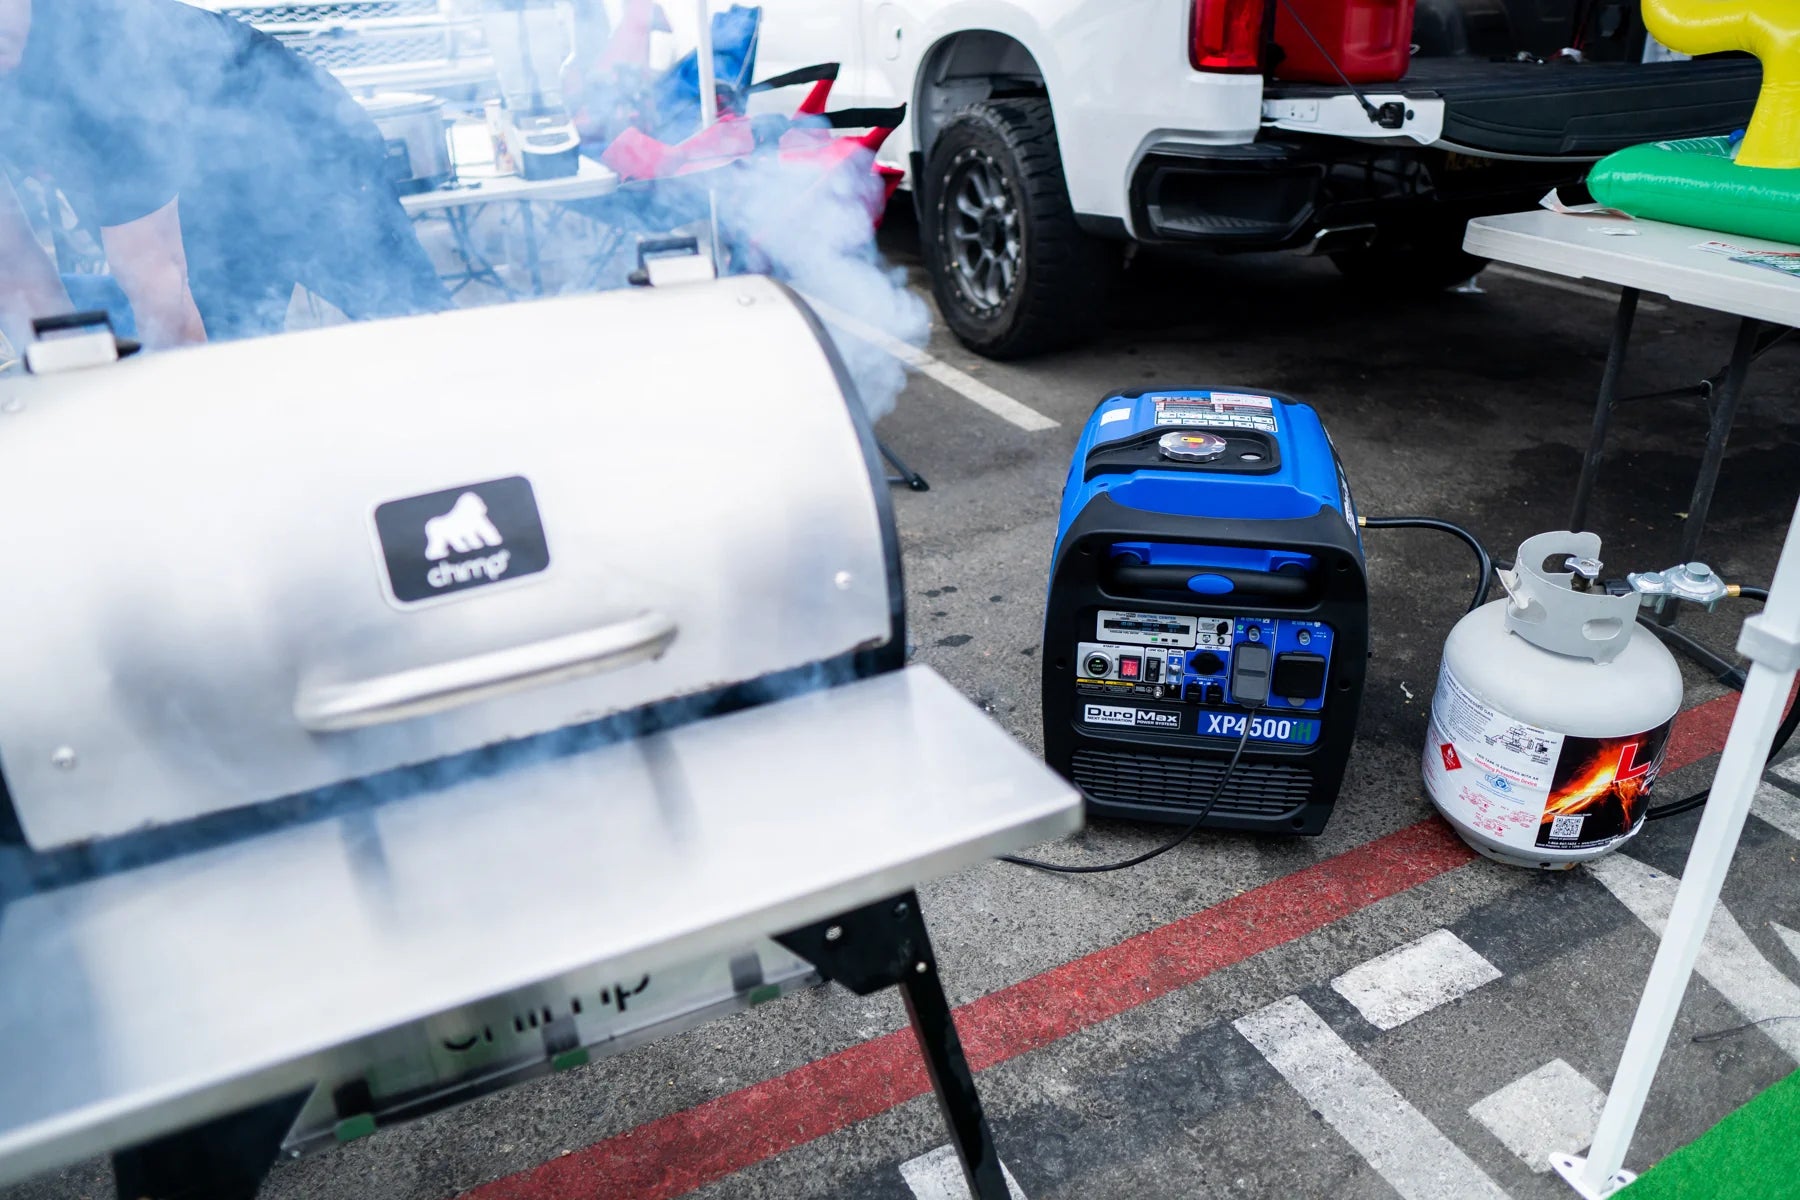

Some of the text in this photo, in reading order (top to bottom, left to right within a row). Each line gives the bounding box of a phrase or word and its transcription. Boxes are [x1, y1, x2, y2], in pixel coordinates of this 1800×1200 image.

[1087, 707, 1178, 723] Duro Max
[1207, 714, 1313, 742] XP4500iH
[1495, 768, 1521, 782] Prevention
[1520, 778, 1538, 788] Device
